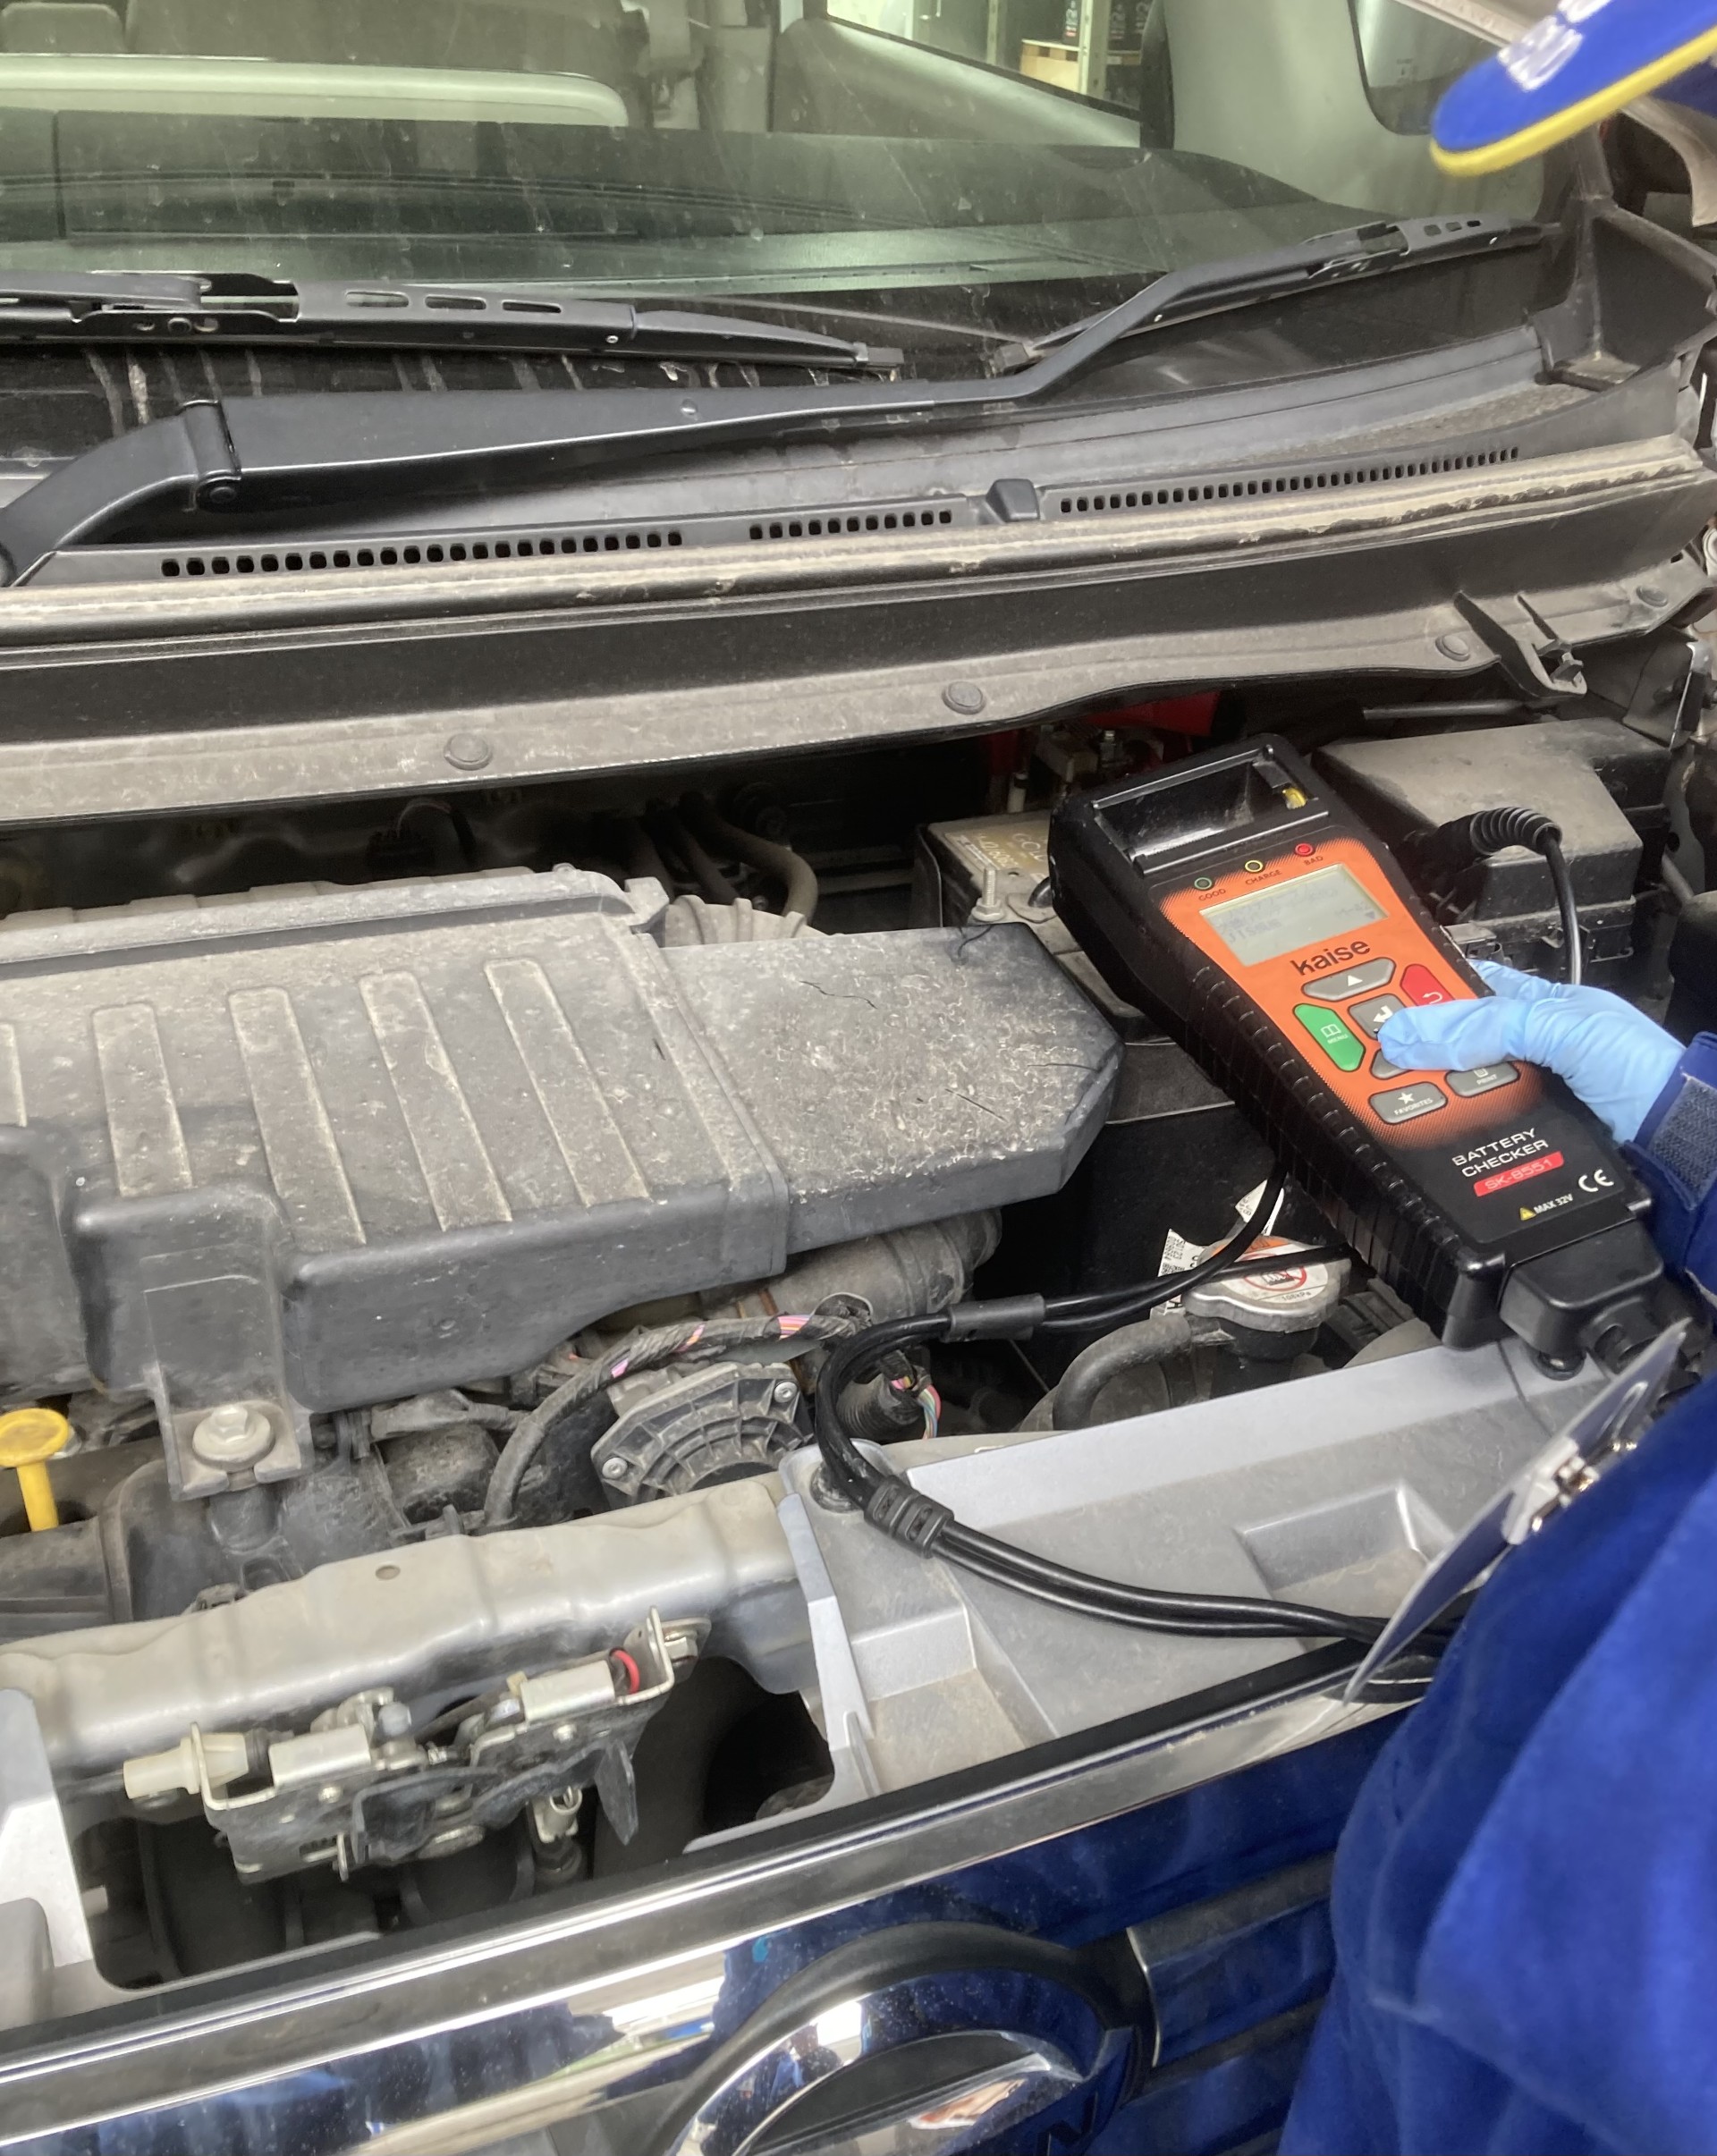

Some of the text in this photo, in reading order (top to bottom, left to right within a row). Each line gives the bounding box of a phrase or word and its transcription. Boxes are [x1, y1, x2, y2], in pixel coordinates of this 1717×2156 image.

[1304, 855, 1324, 866] BAD
[1245, 869, 1281, 885] CHARGE
[1198, 888, 1226, 901] GOOD
[1290, 941, 1370, 976] kaise
[1327, 1033, 1348, 1044] MENU
[1476, 1074, 1497, 1086] PRINT
[1394, 1097, 1434, 1116] FAVORITES
[1451, 1128, 1536, 1166] BATTERY
[1461, 1139, 1549, 1178] CHECKER
[1484, 1158, 1553, 1190] SK-8551
[1578, 1169, 1615, 1192] CE
[1533, 1193, 1574, 1214] MAX 32V
